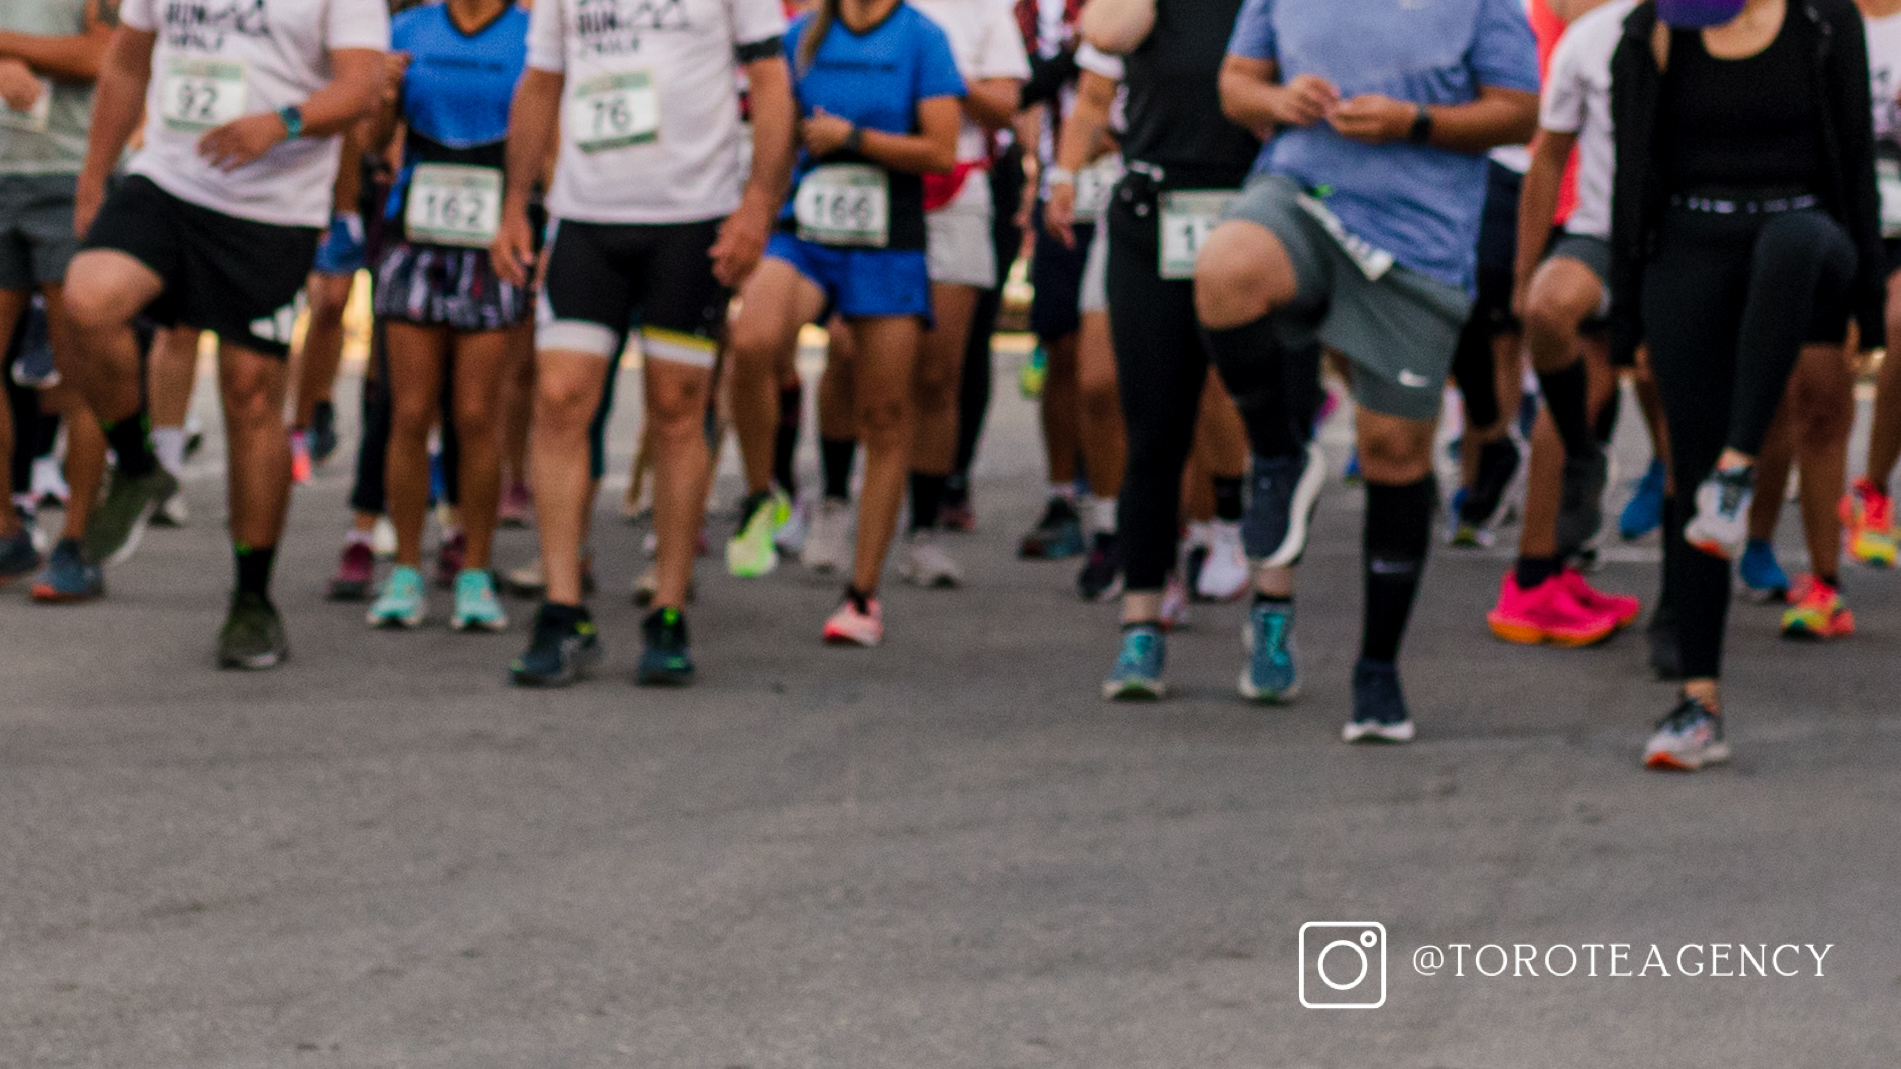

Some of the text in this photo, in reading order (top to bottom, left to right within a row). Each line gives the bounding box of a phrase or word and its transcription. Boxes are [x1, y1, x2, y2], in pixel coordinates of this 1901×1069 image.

[178, 83, 219, 120] 92
[591, 97, 633, 136] 76
[424, 192, 487, 230] 162
[812, 192, 876, 231] 166
